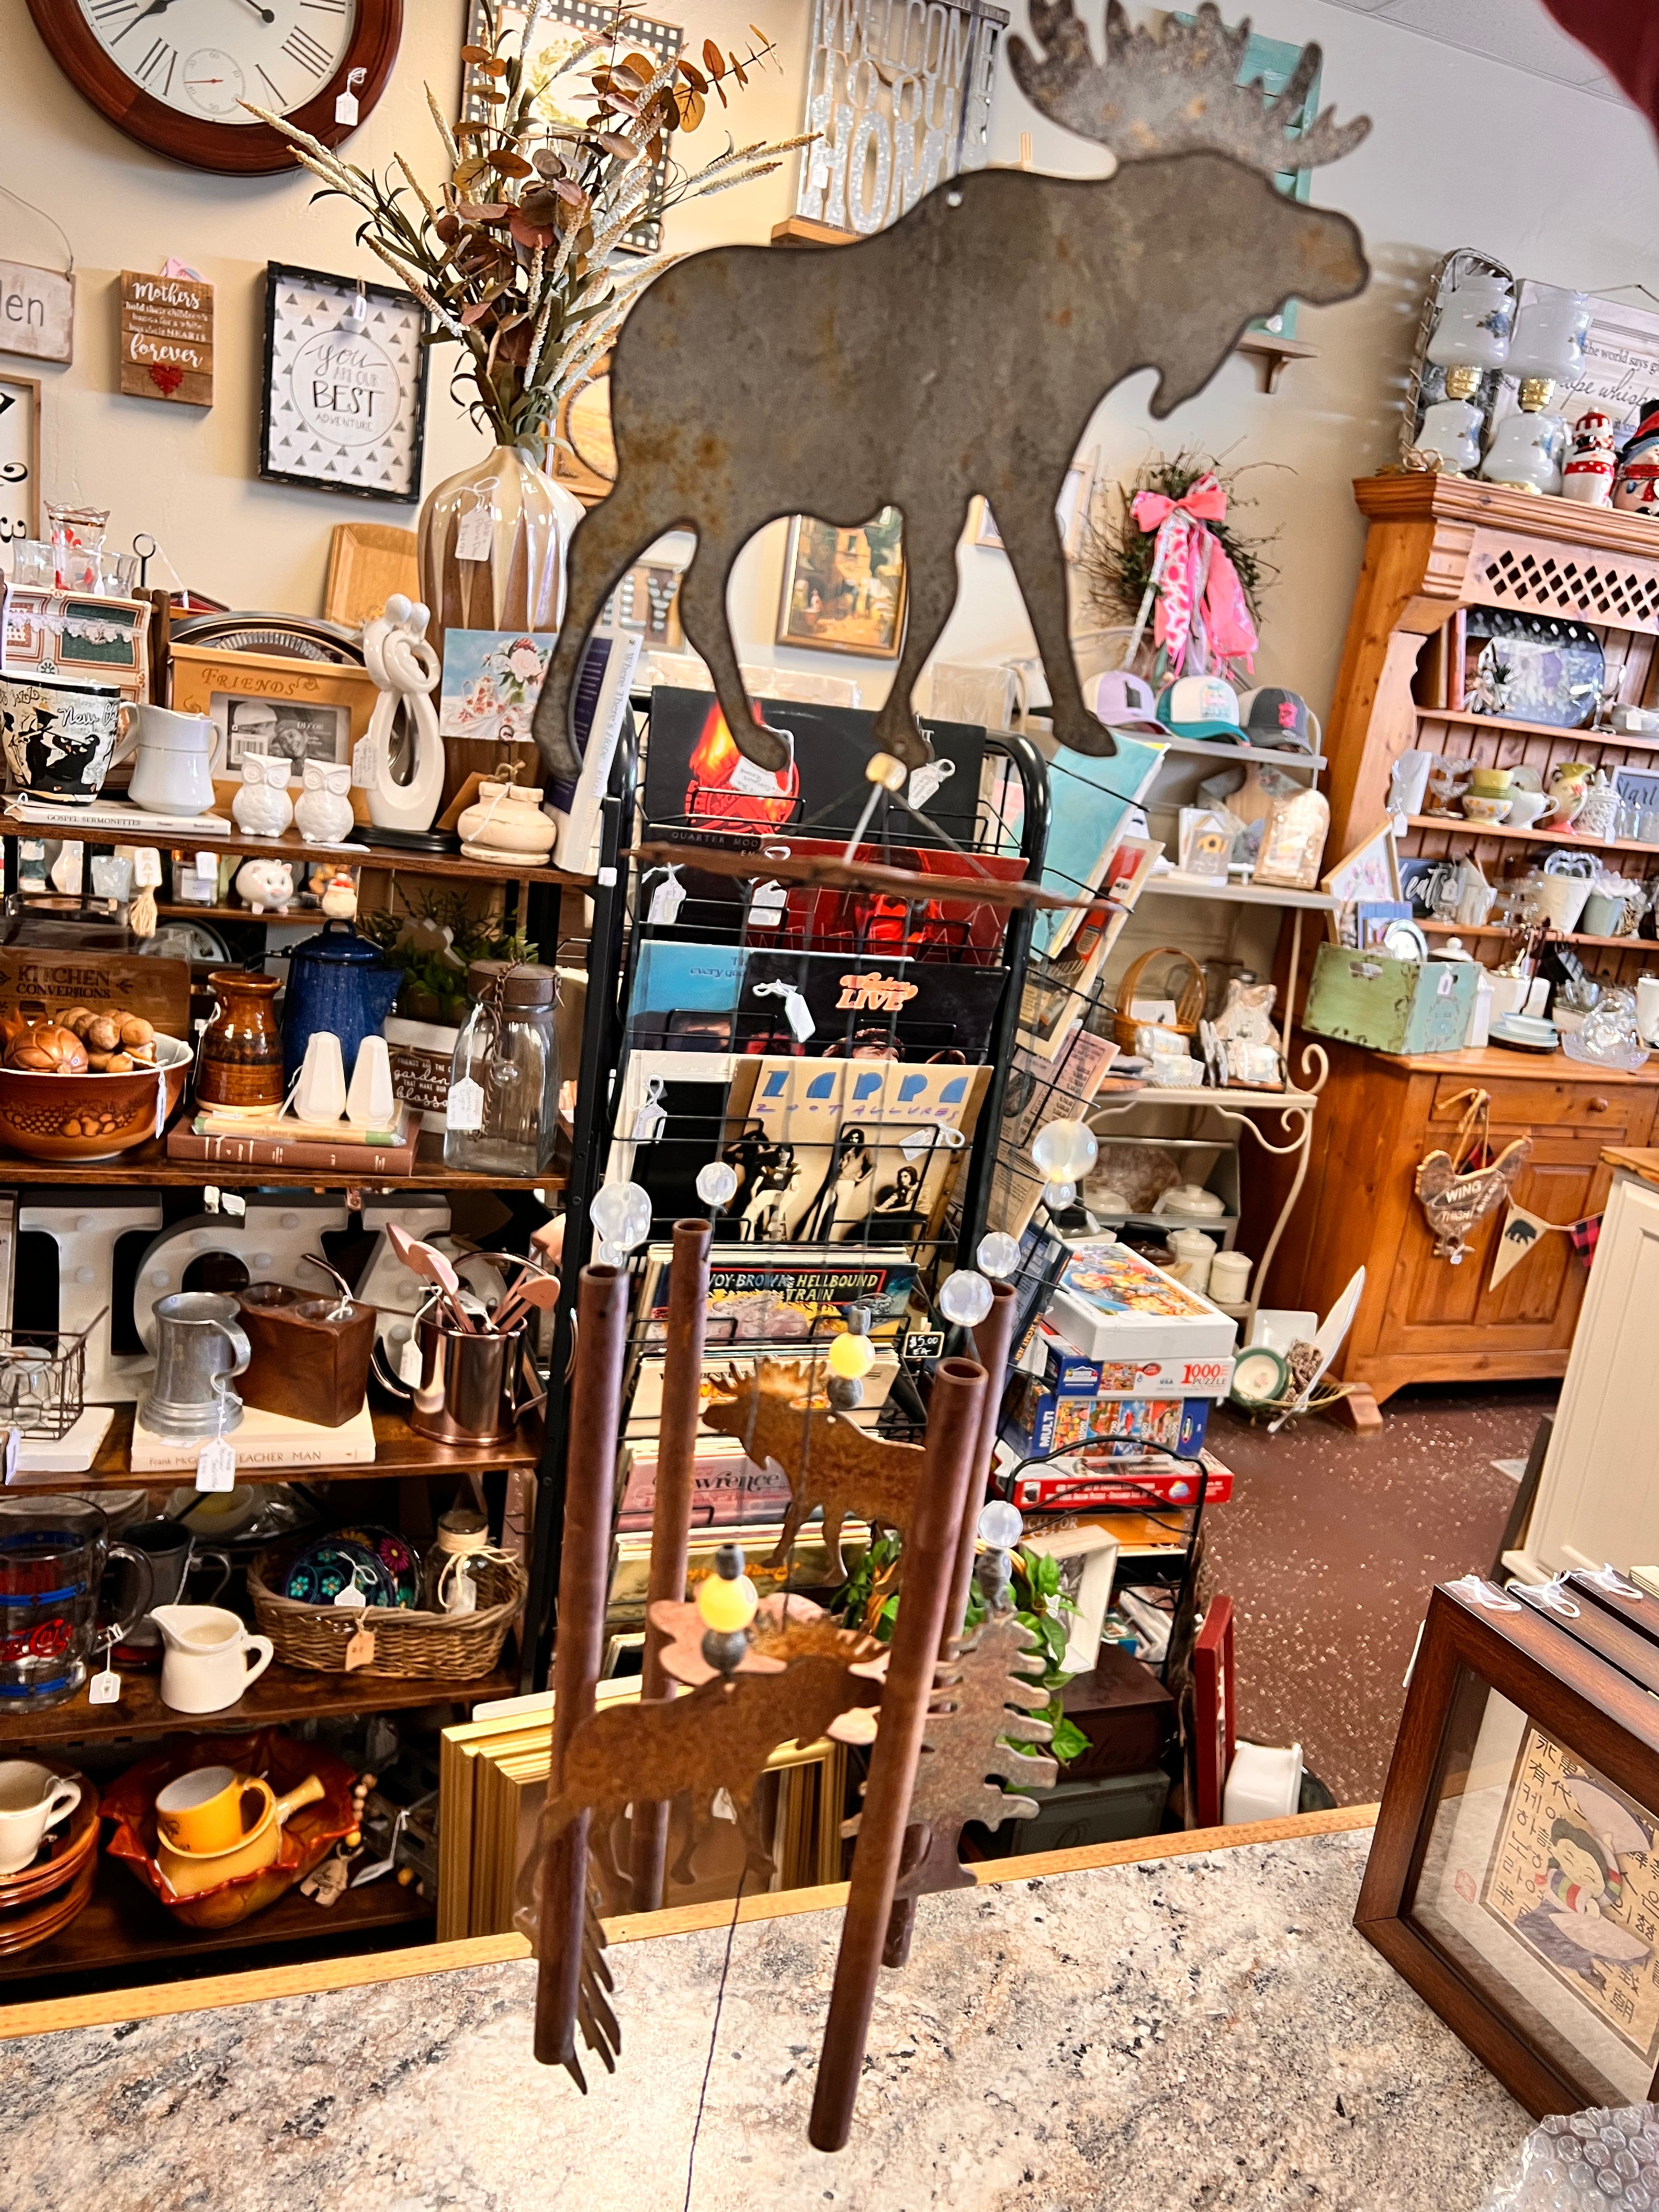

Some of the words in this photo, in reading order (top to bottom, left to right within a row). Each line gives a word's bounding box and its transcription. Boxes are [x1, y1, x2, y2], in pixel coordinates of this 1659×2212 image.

[132, 282, 200, 309] Mothers
[130, 332, 204, 368] forever
[304, 344, 388, 377] you
[1601, 349, 1630, 364] world
[1628, 356, 1649, 371] says
[312, 380, 386, 417] BEST
[315, 412, 374, 432] ADVENTURE
[616, 652, 635, 688] Where
[202, 668, 298, 696] FRIENDS
[58, 706, 100, 727] New
[607, 689, 624, 730] There's
[47, 814, 79, 822] GOSPEL
[82, 816, 141, 826] SERMONETTES
[672, 831, 725, 844] QUARTER
[18, 965, 110, 986] KITCHEN
[690, 967, 723, 978] every
[835, 988, 908, 1012] LIVE
[397, 1057, 419, 1067] FRIENDS
[435, 1063, 445, 1071] THE
[404, 1079, 416, 1087] THAT
[419, 1082, 433, 1091] MAKE
[436, 1084, 447, 1092] OUR
[1446, 1180, 1482, 1204] WING
[797, 1274, 879, 1288] HELLBOUND
[786, 1288, 834, 1302] TRAIN
[909, 1335, 939, 1348] $5.00
[1180, 1363, 1221, 1384] 1000
[1039, 1411, 1054, 1447] MULTI
[291, 1451, 321, 1462] MAN
